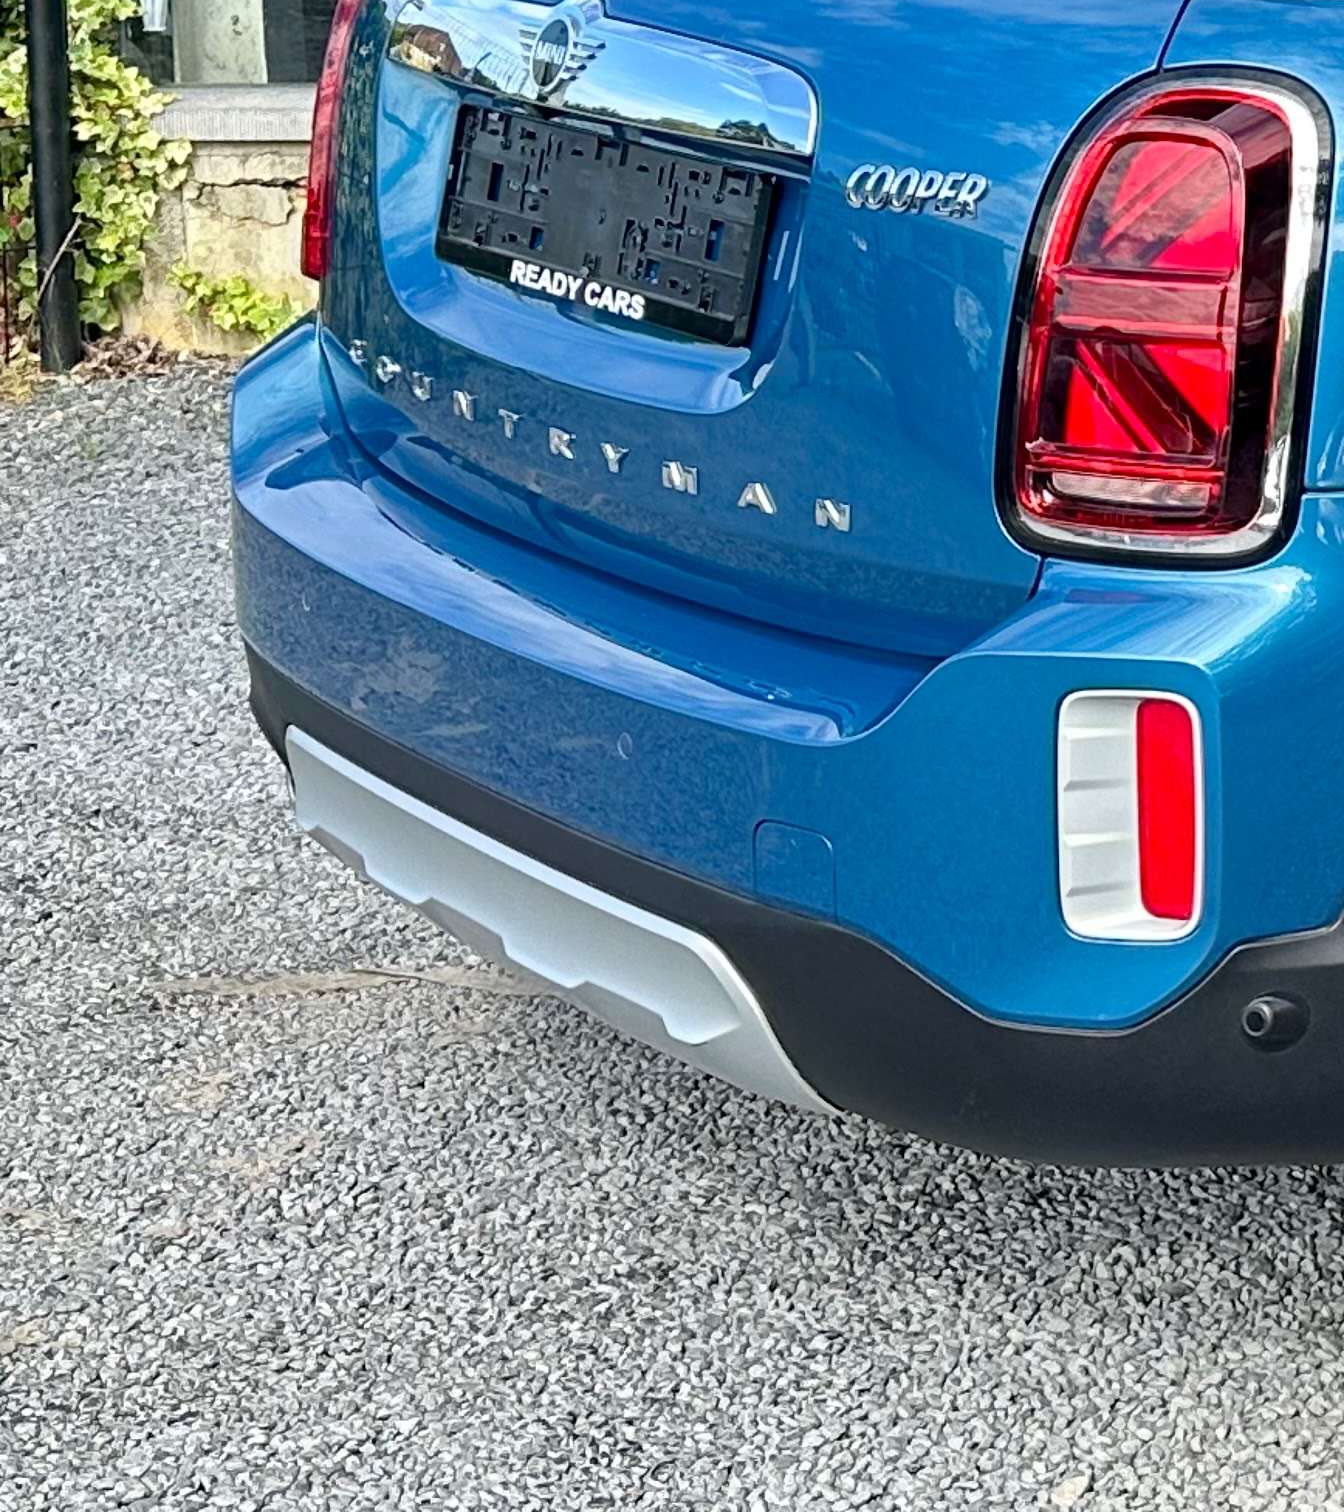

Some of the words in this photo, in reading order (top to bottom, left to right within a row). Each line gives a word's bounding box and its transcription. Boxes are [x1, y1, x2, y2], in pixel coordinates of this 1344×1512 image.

[536, 40, 566, 65] MINI
[846, 164, 986, 220] COOPER
[510, 259, 583, 300] READY
[584, 281, 646, 320] CARS
[349, 338, 852, 533] COUNTRYMAN
